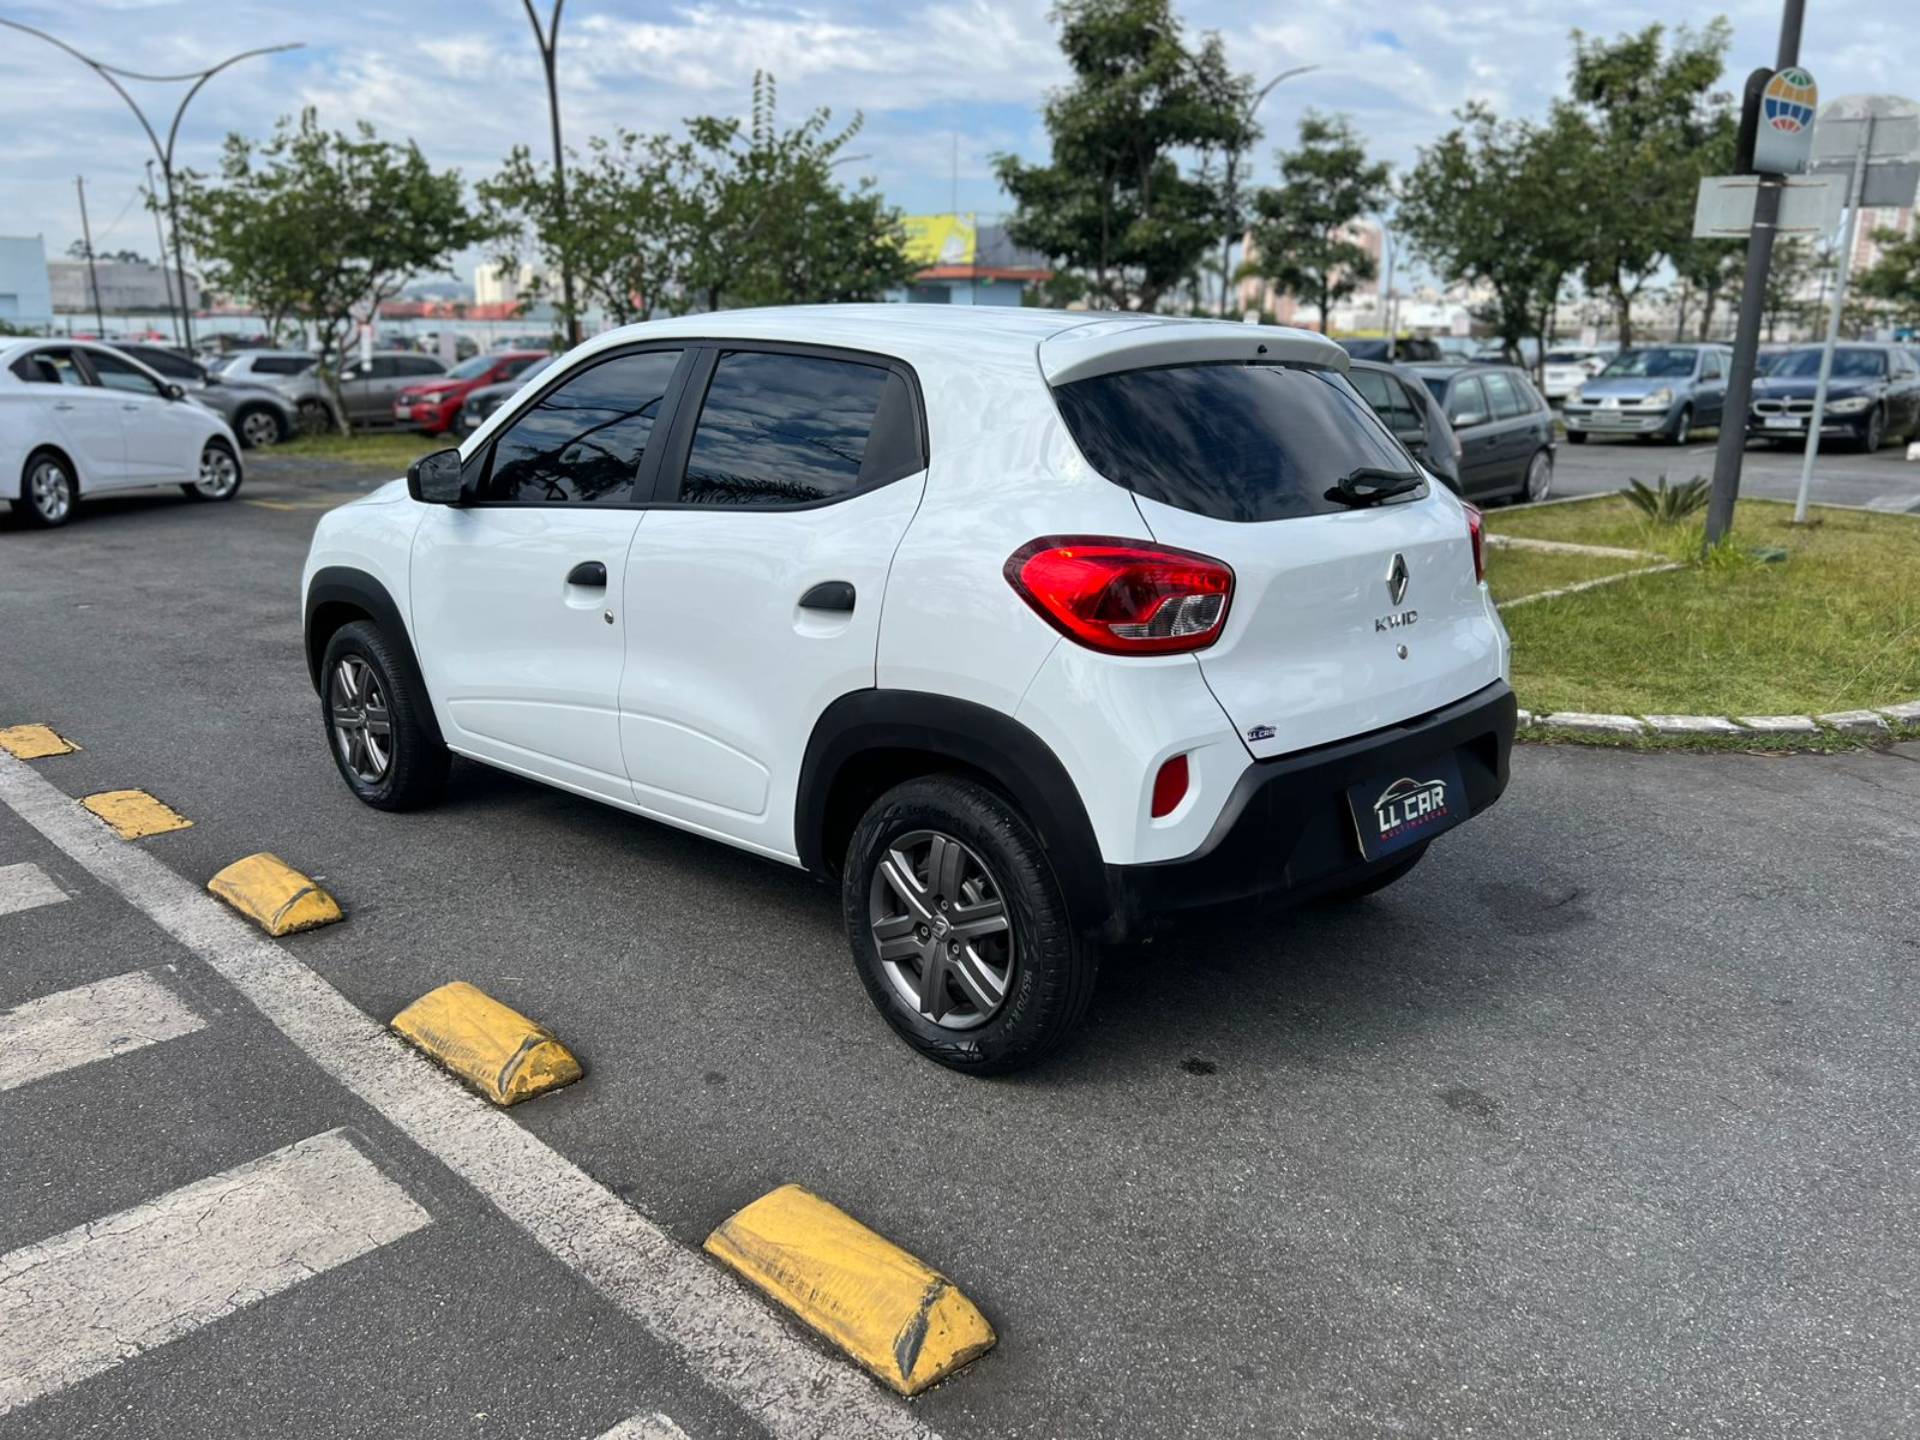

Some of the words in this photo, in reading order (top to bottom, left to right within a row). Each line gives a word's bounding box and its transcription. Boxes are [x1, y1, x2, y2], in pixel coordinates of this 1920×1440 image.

[1375, 610, 1418, 633] KWID
[1378, 804, 1402, 832] LL
[1403, 786, 1445, 820] CAR
